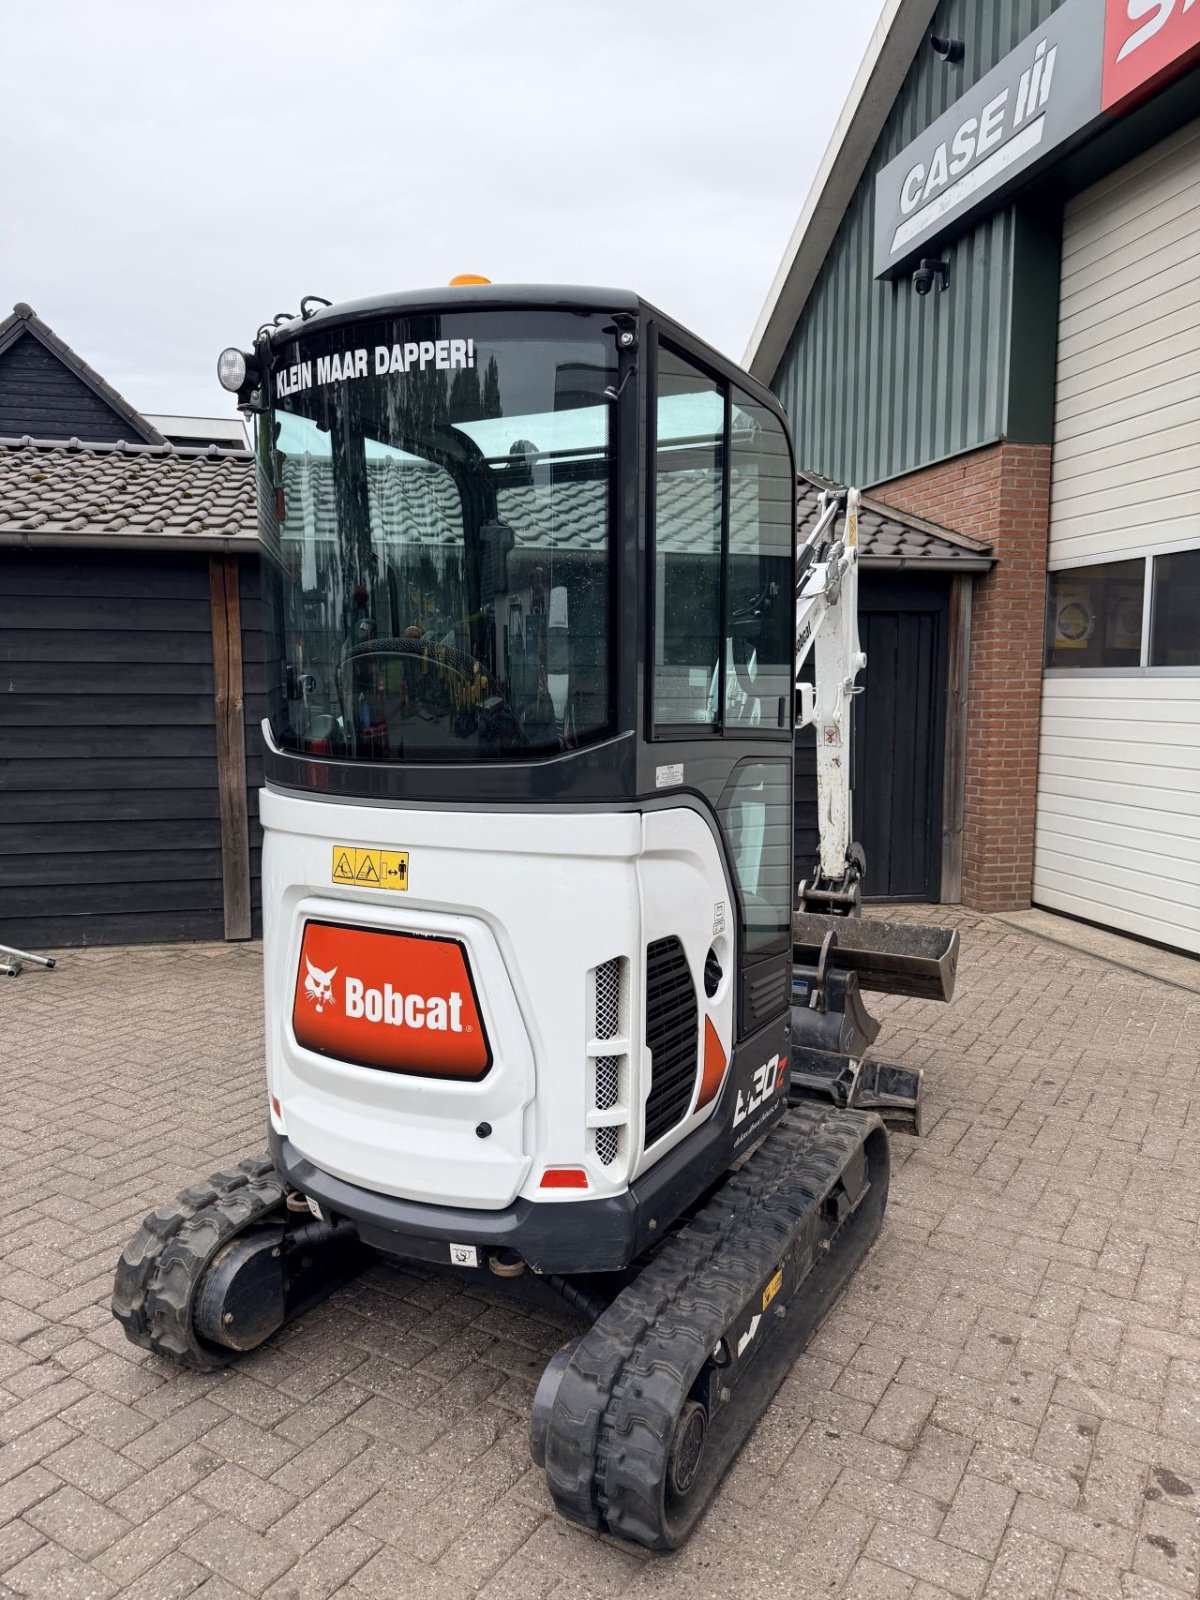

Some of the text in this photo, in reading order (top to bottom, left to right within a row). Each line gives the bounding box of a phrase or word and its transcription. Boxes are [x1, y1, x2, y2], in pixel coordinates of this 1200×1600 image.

[900, 87, 1009, 215] CASE
[276, 339, 475, 399] KLEIN MAAR DAPPER!
[795, 619, 812, 657] obcat
[345, 976, 463, 1033] Bobcat
